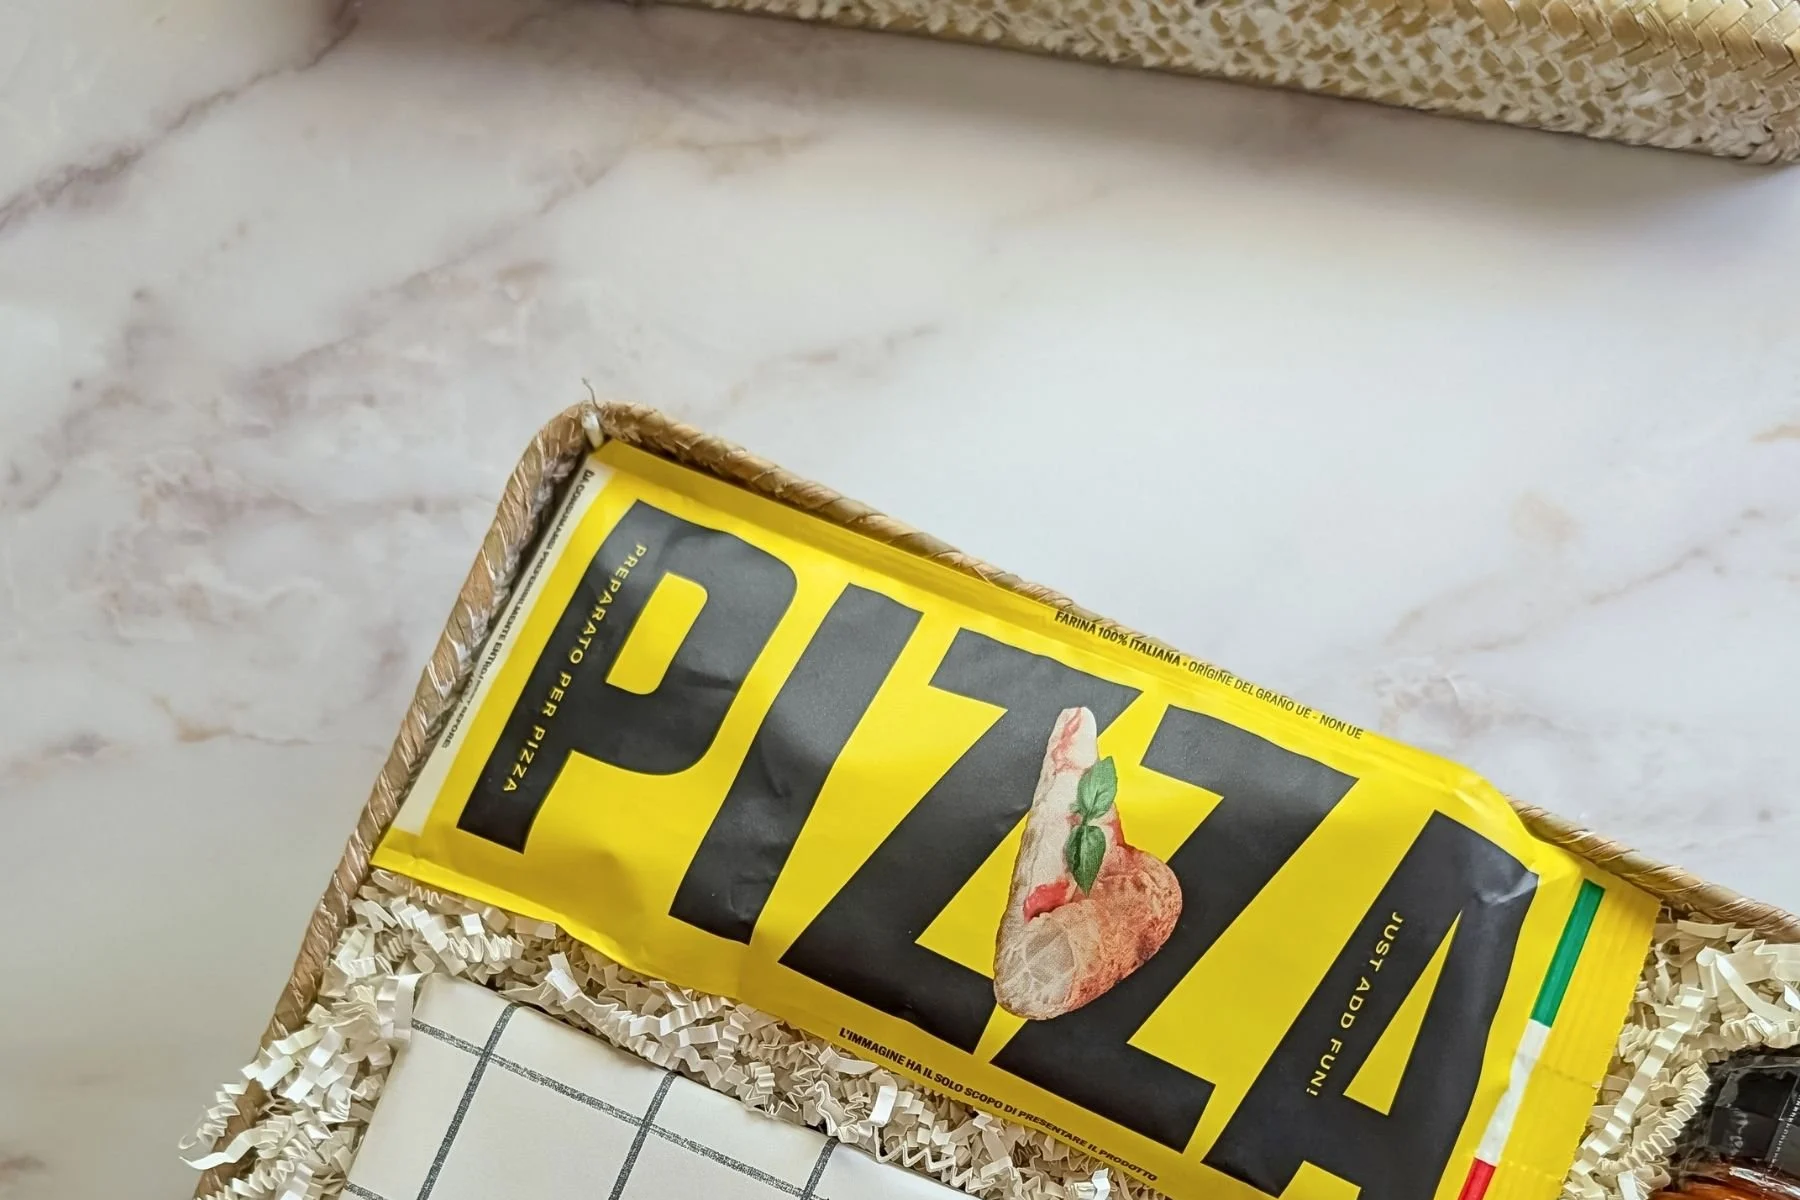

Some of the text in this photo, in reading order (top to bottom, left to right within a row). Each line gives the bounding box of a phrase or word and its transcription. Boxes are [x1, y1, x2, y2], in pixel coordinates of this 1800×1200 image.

[503, 543, 648, 792] PREPARATO PER PIZZA
[1054, 611, 1096, 635] FARINA
[1098, 627, 1128, 646] 100%
[1128, 638, 1181, 667] ITALIANA
[1188, 661, 1239, 686] ORIGINE
[1234, 679, 1255, 696] DEL
[1255, 688, 1294, 712] GRANO
[1295, 705, 1312, 720] UE
[1319, 714, 1346, 733] NON
[1346, 724, 1364, 740] UE
[1306, 912, 1404, 1096] JUST ADD FUN!
[839, 1027, 1158, 1182] L'IMMAGINE HA IL SOLO SCOPO DI PRESENTARE IL PRODOTTO
